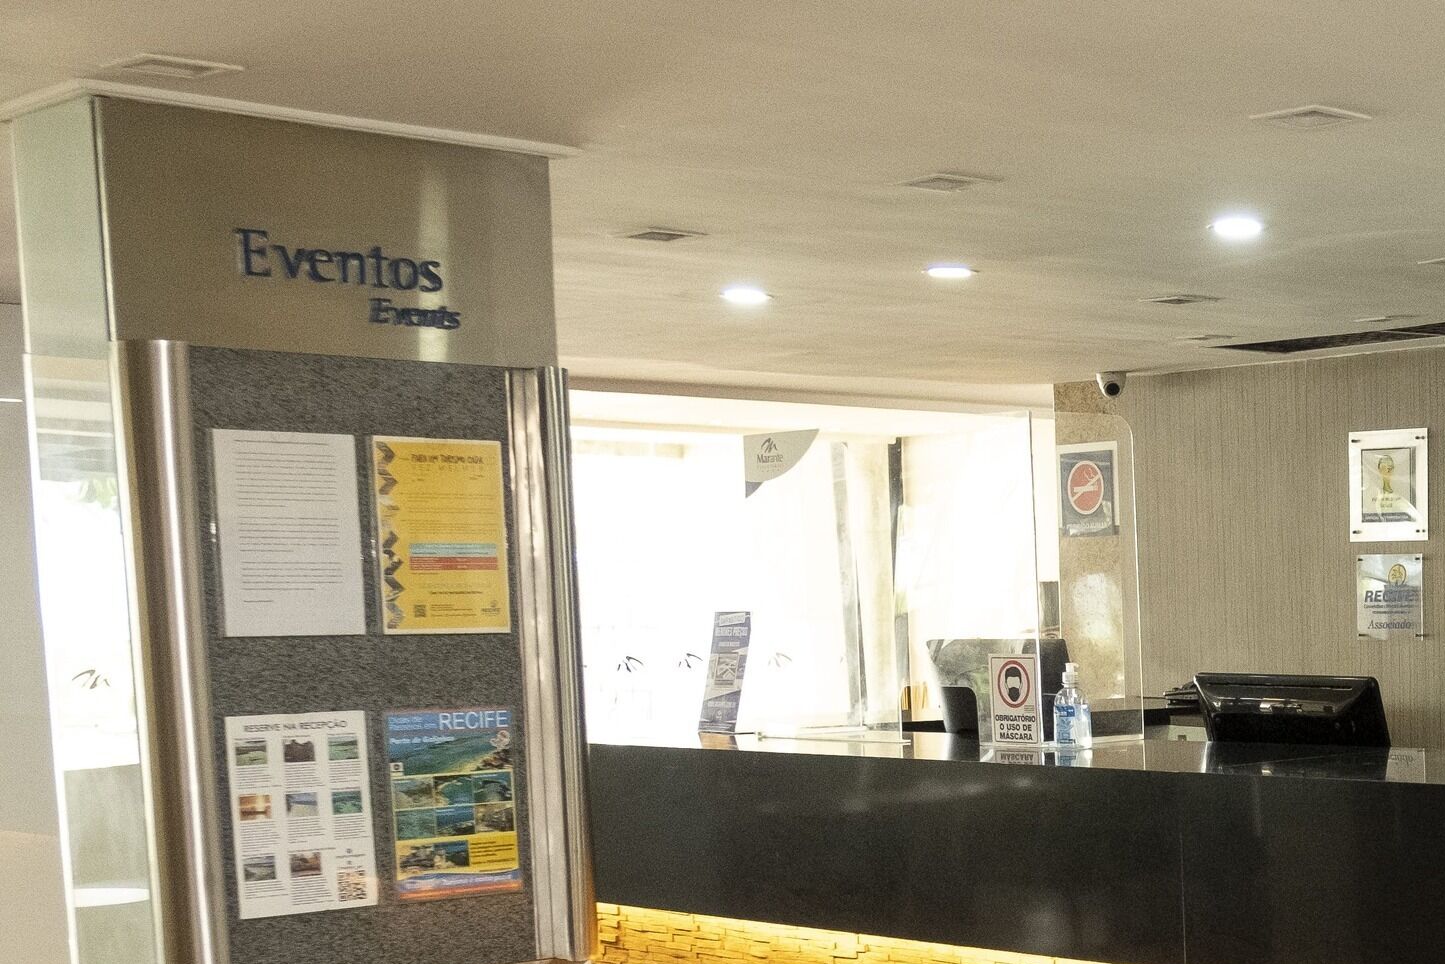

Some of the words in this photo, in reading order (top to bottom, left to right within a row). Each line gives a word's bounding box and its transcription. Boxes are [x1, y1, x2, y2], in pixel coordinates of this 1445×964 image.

[233, 227, 443, 292] Eventos
[368, 297, 462, 329] Events
[439, 710, 509, 730] RECIFE
[995, 713, 1036, 723] OBRIGATÓRIO
[1000, 723, 1005, 731] O
[1006, 723, 1021, 732] USO
[1022, 724, 1032, 732] DE
[1000, 730, 1033, 741] MÁSCARA
